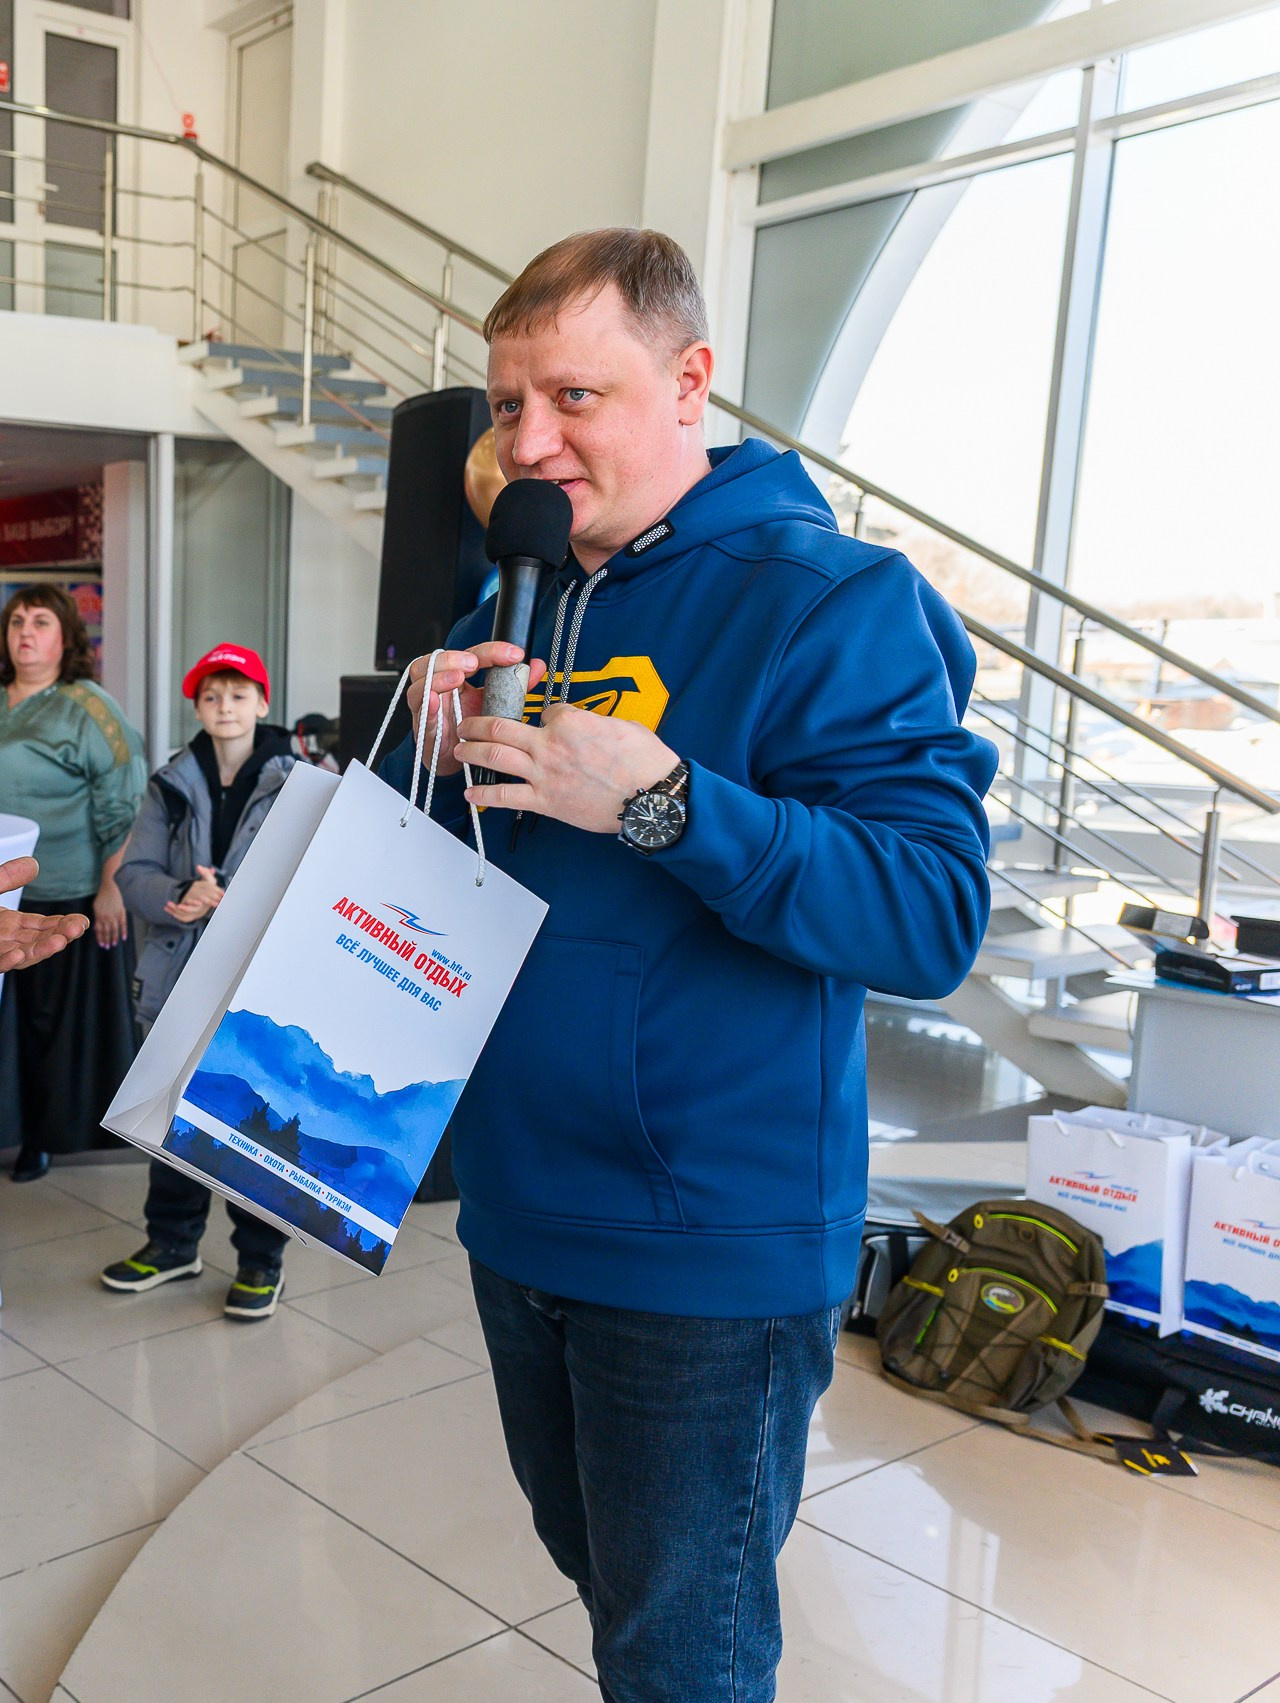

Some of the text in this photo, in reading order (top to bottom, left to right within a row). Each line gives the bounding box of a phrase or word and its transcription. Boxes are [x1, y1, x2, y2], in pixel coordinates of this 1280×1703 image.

[332, 896, 468, 999] АКТИВНЫЙ ОТДЫХ
[335, 933, 442, 1012] ВСЁ ЛУЧШЕЕ ДЛЯ ВАС
[431, 949, 472, 981] www.hft.ru
[228, 1133, 352, 1213] ТЕХНИКА ОХОТА РЫБАЛКА ТУРИЗМ
